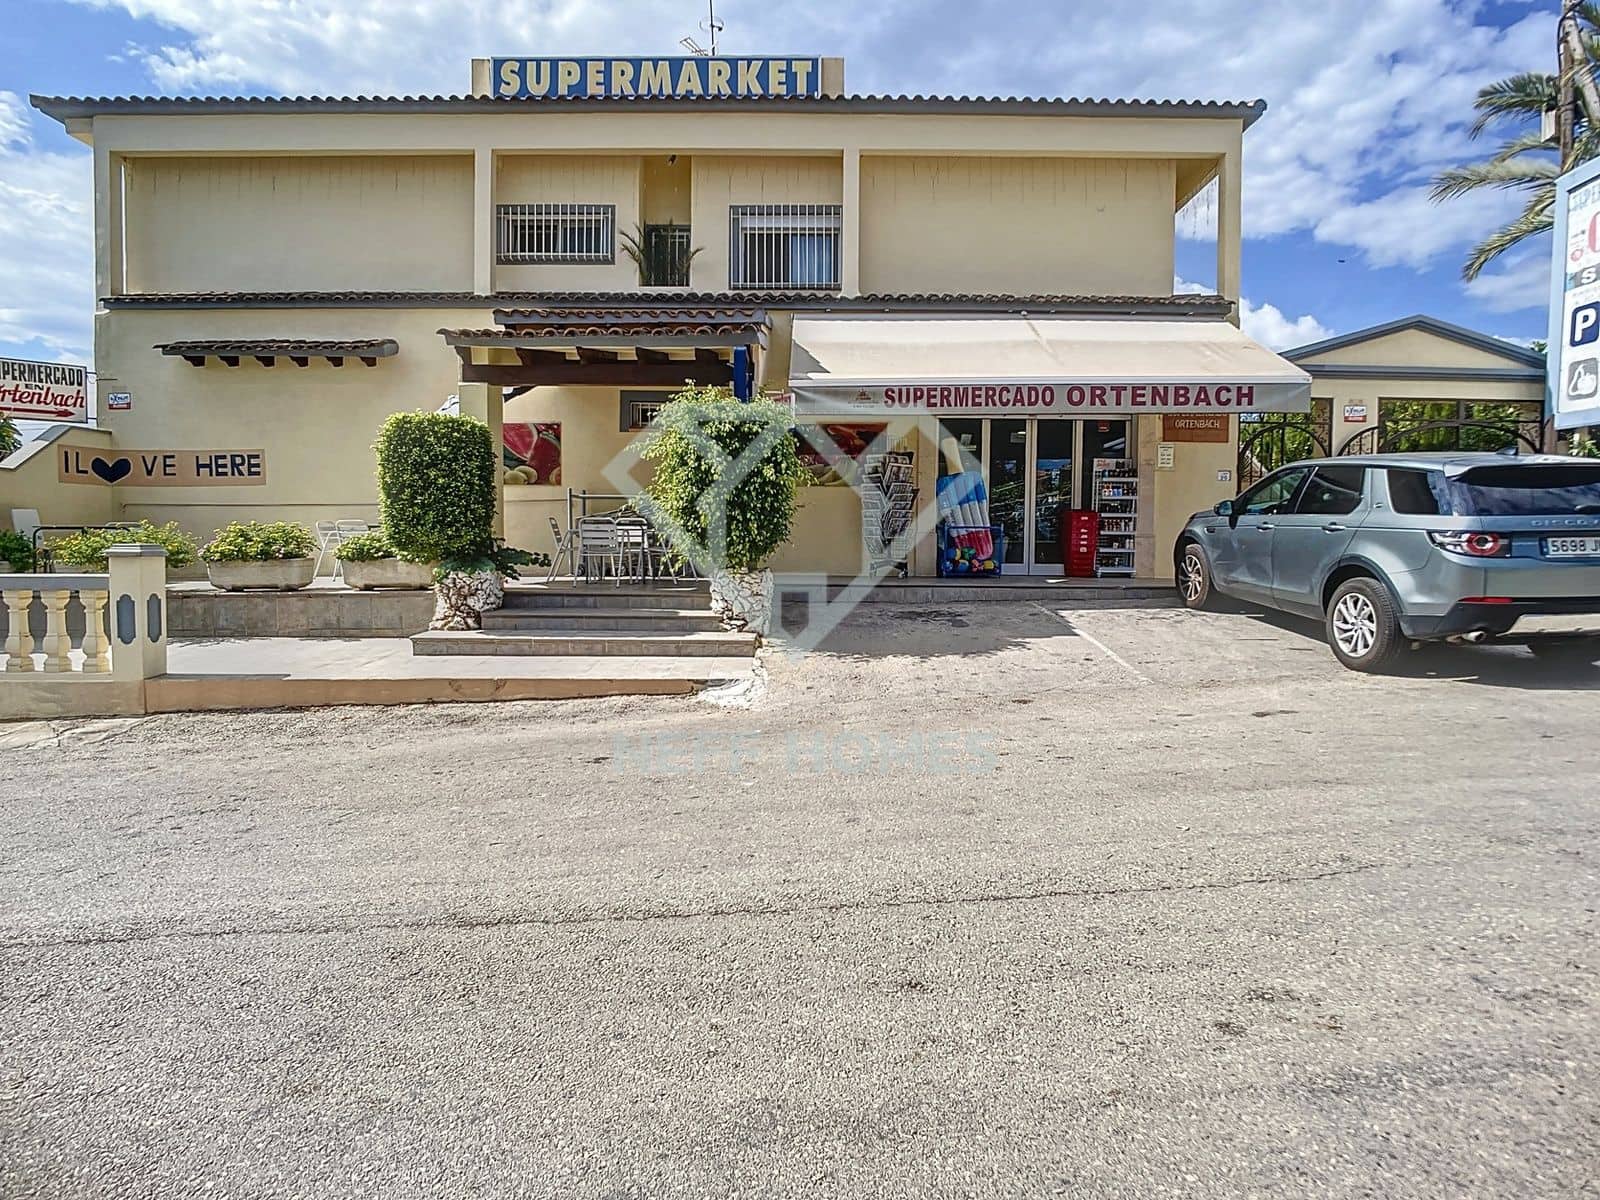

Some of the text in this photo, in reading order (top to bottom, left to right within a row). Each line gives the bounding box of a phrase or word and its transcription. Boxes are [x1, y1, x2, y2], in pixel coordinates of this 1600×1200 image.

[499, 60, 813, 98] SUPERMARKET
[0, 360, 84, 387] PERMERCADO
[0, 383, 85, 408] rtenbach
[884, 385, 1255, 408] SUPERMERCADO ORTENBACH
[1174, 419, 1220, 429] ORTENBACH
[195, 454, 262, 477] HERE
[1551, 539, 1586, 552] 5698
